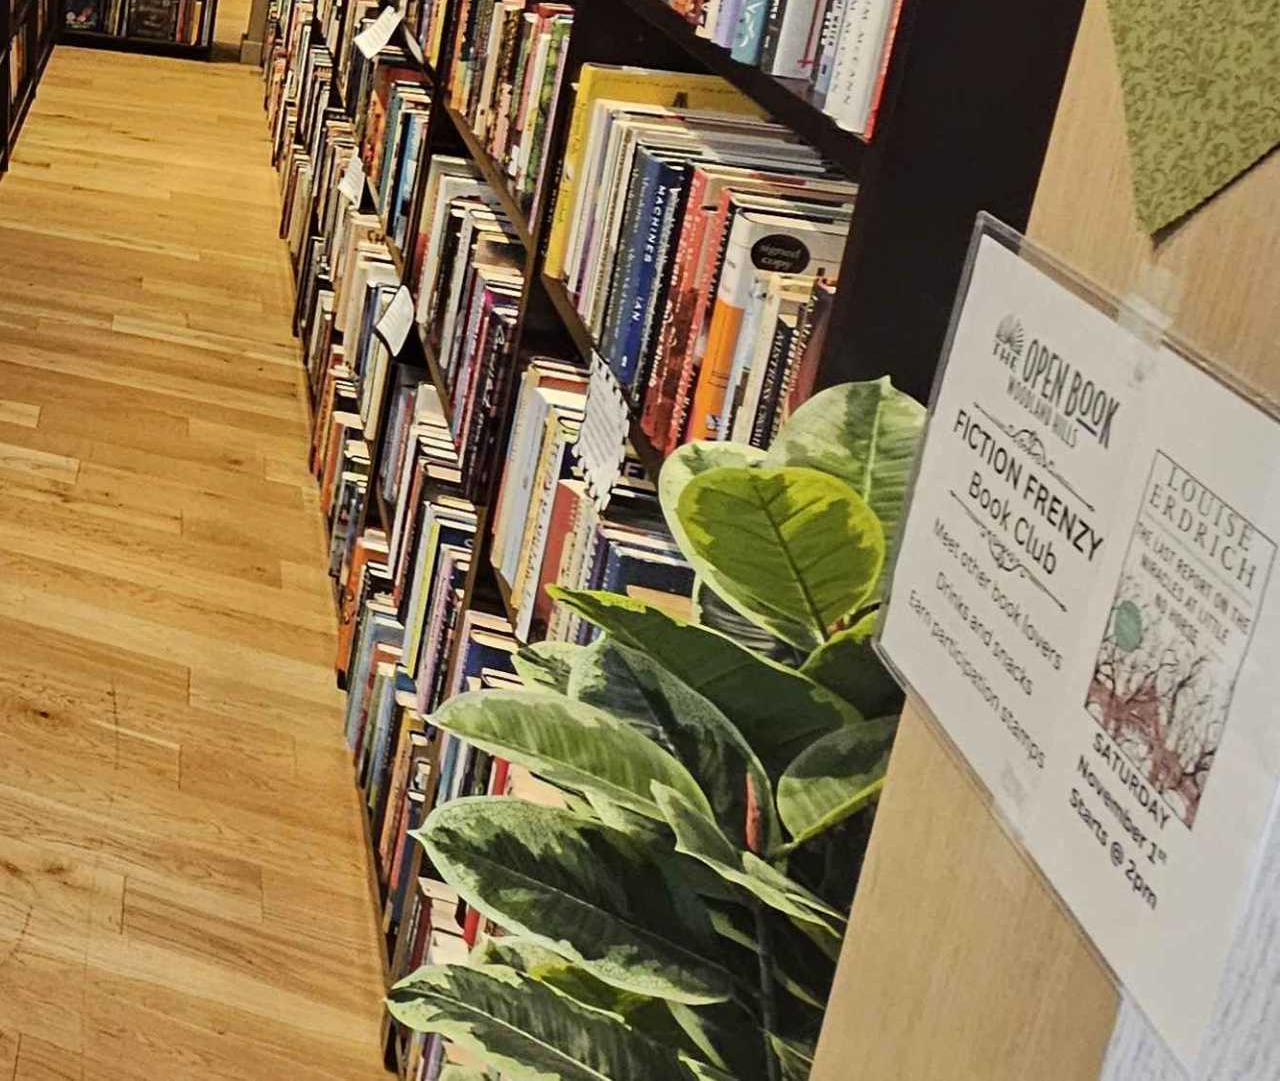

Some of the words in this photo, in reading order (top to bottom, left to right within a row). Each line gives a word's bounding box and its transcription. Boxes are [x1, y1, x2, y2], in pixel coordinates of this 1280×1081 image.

[644, 185, 666, 264] MACHINES
[761, 245, 803, 259] signed
[761, 257, 793, 271] copy
[631, 296, 646, 322] IAN
[992, 341, 1019, 372] THE
[1023, 339, 1071, 408] OPEN
[1064, 370, 1120, 449] BOOK
[1006, 374, 1053, 427] WOODLAND
[1051, 411, 1079, 449] HILLS
[953, 409, 1023, 490] FICTION
[1023, 474, 1104, 562] FRENZY
[968, 471, 1012, 531] Book
[1014, 516, 1057, 575] Club
[1149, 484, 1257, 591] ERDRICH
[1167, 466, 1251, 552] LOUISE
[933, 518, 960, 559] Meet
[960, 551, 991, 590] other
[991, 585, 1021, 628] book
[1021, 613, 1063, 671] lovers
[1153, 535, 1176, 564] LAST
[908, 589, 932, 627] Earn
[930, 621, 1000, 712] participation
[999, 705, 1046, 770] stamps
[935, 571, 970, 621] Drinks
[969, 615, 993, 647] and
[992, 640, 1033, 696] snacks
[1077, 754, 1149, 849] November
[1146, 841, 1169, 867] 1st
[1092, 732, 1171, 831] SATURDAY
[1069, 787, 1109, 847] Starts
[1109, 840, 1125, 868] @
[1124, 858, 1159, 911] 2pm
